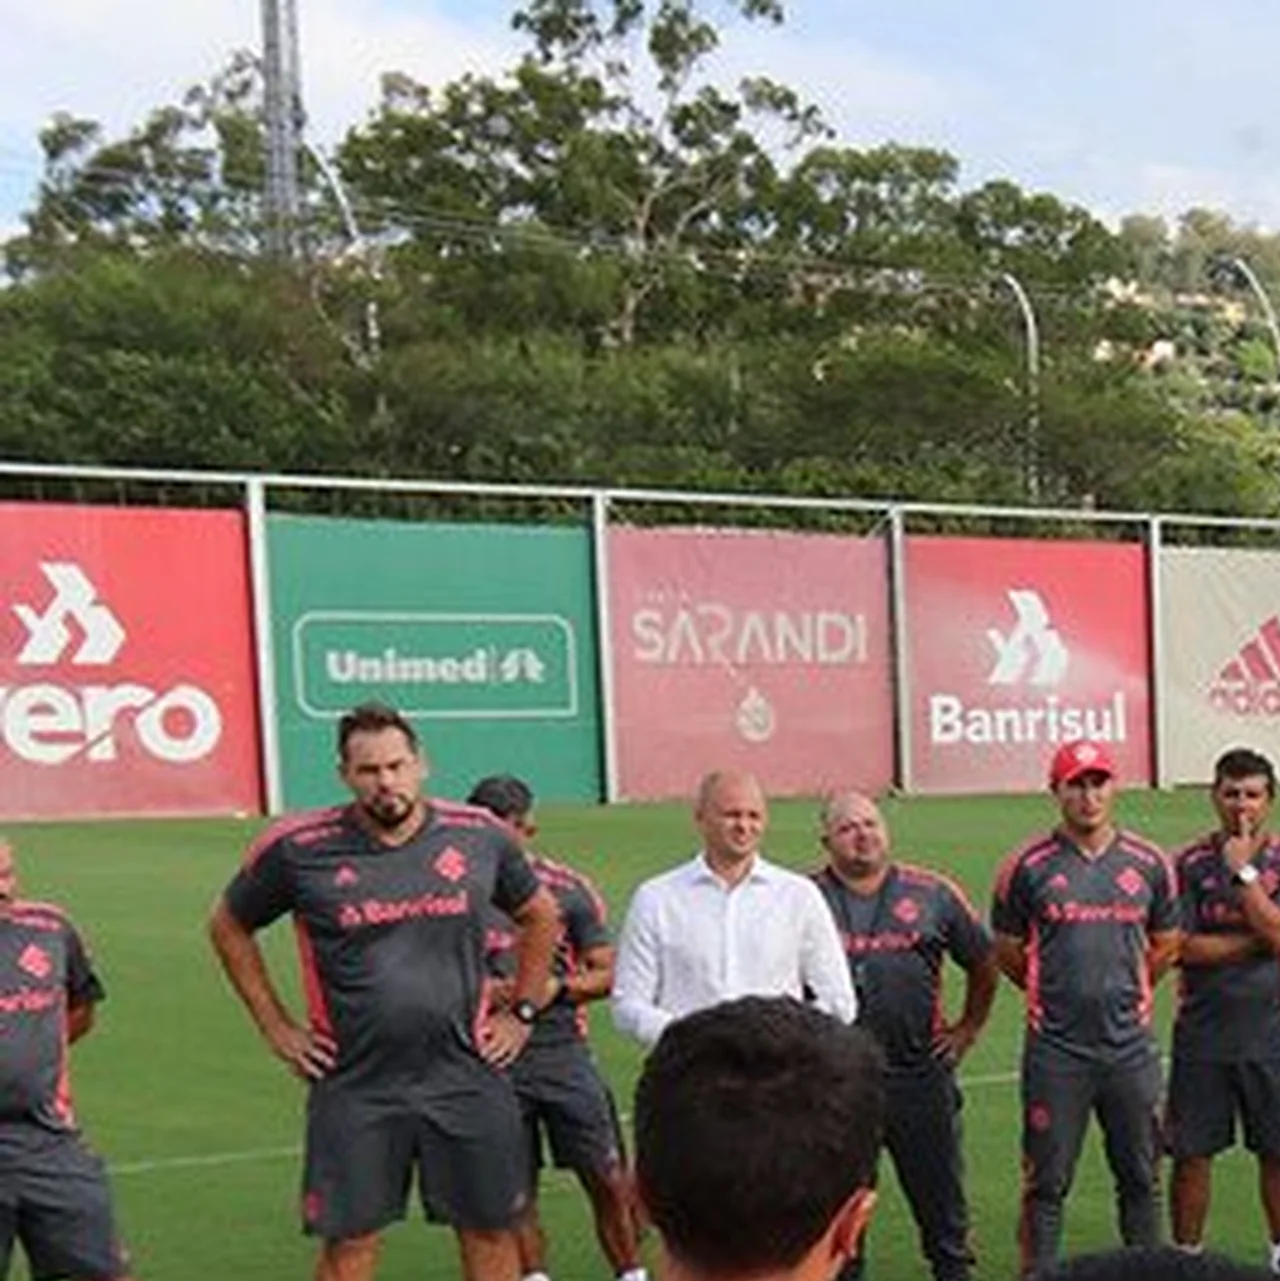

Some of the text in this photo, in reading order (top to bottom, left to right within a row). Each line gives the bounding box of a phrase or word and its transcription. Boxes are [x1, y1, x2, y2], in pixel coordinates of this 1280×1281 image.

[325, 649, 487, 683] Unimed
[632, 603, 868, 676] SARANDI
[0, 682, 223, 765] ero
[929, 693, 1126, 744] Banrisul
